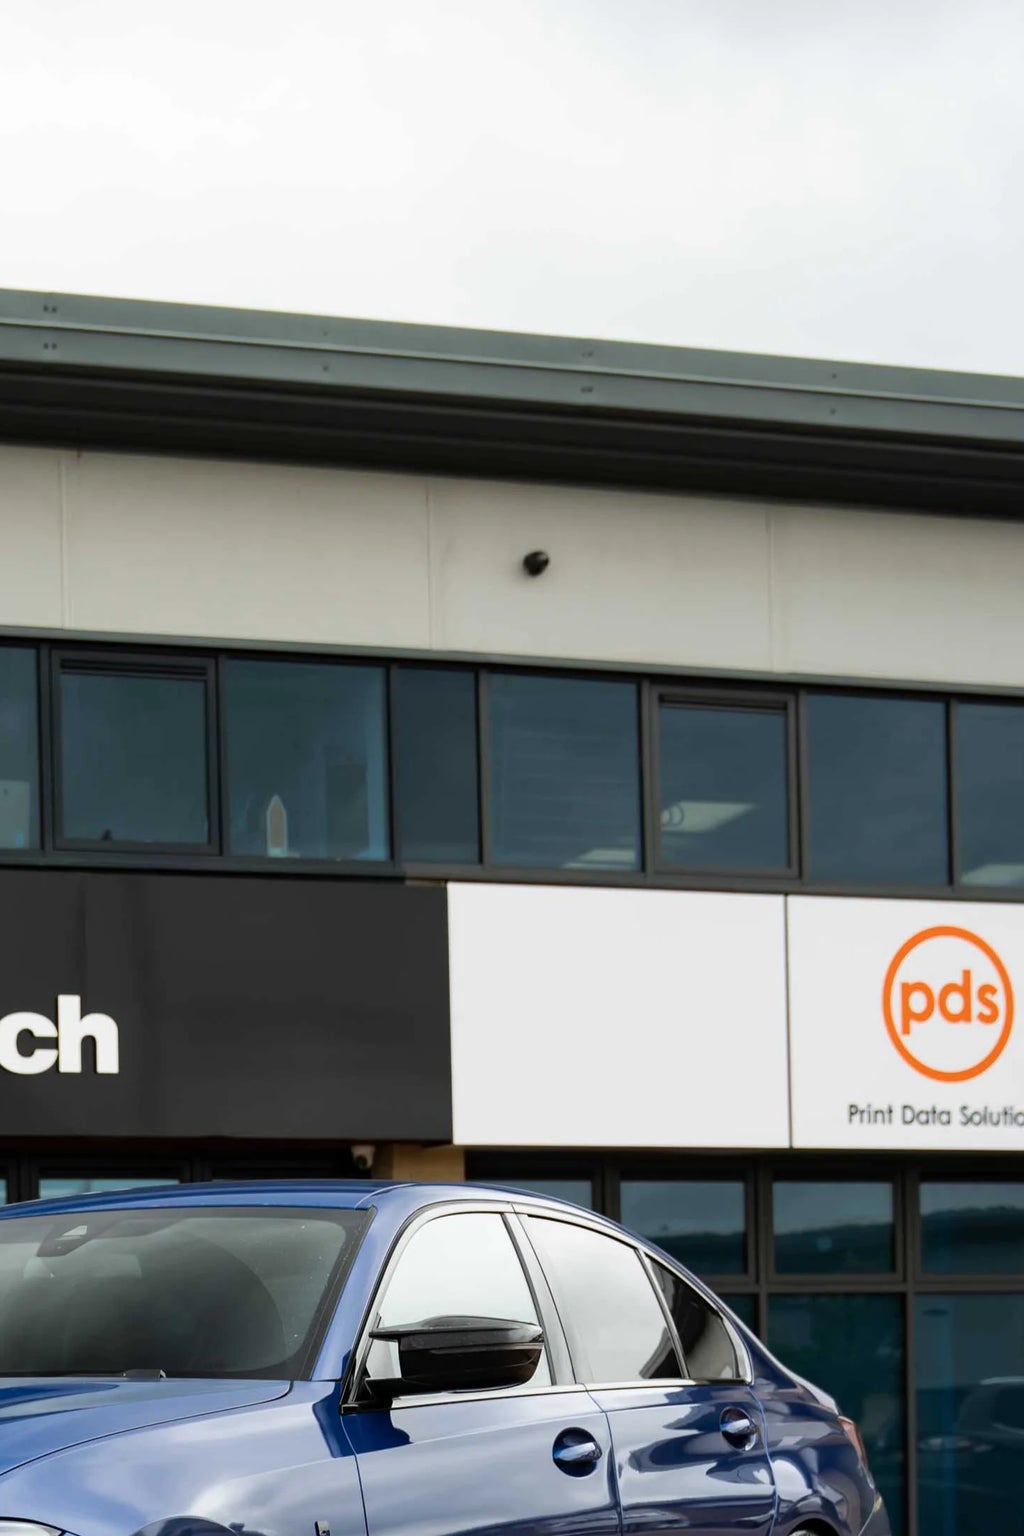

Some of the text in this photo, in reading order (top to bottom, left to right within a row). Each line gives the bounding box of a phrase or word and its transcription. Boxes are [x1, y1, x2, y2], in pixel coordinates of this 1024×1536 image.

[900, 969, 999, 1036] pds
[849, 1103, 1024, 1127] Print Data Solutio
